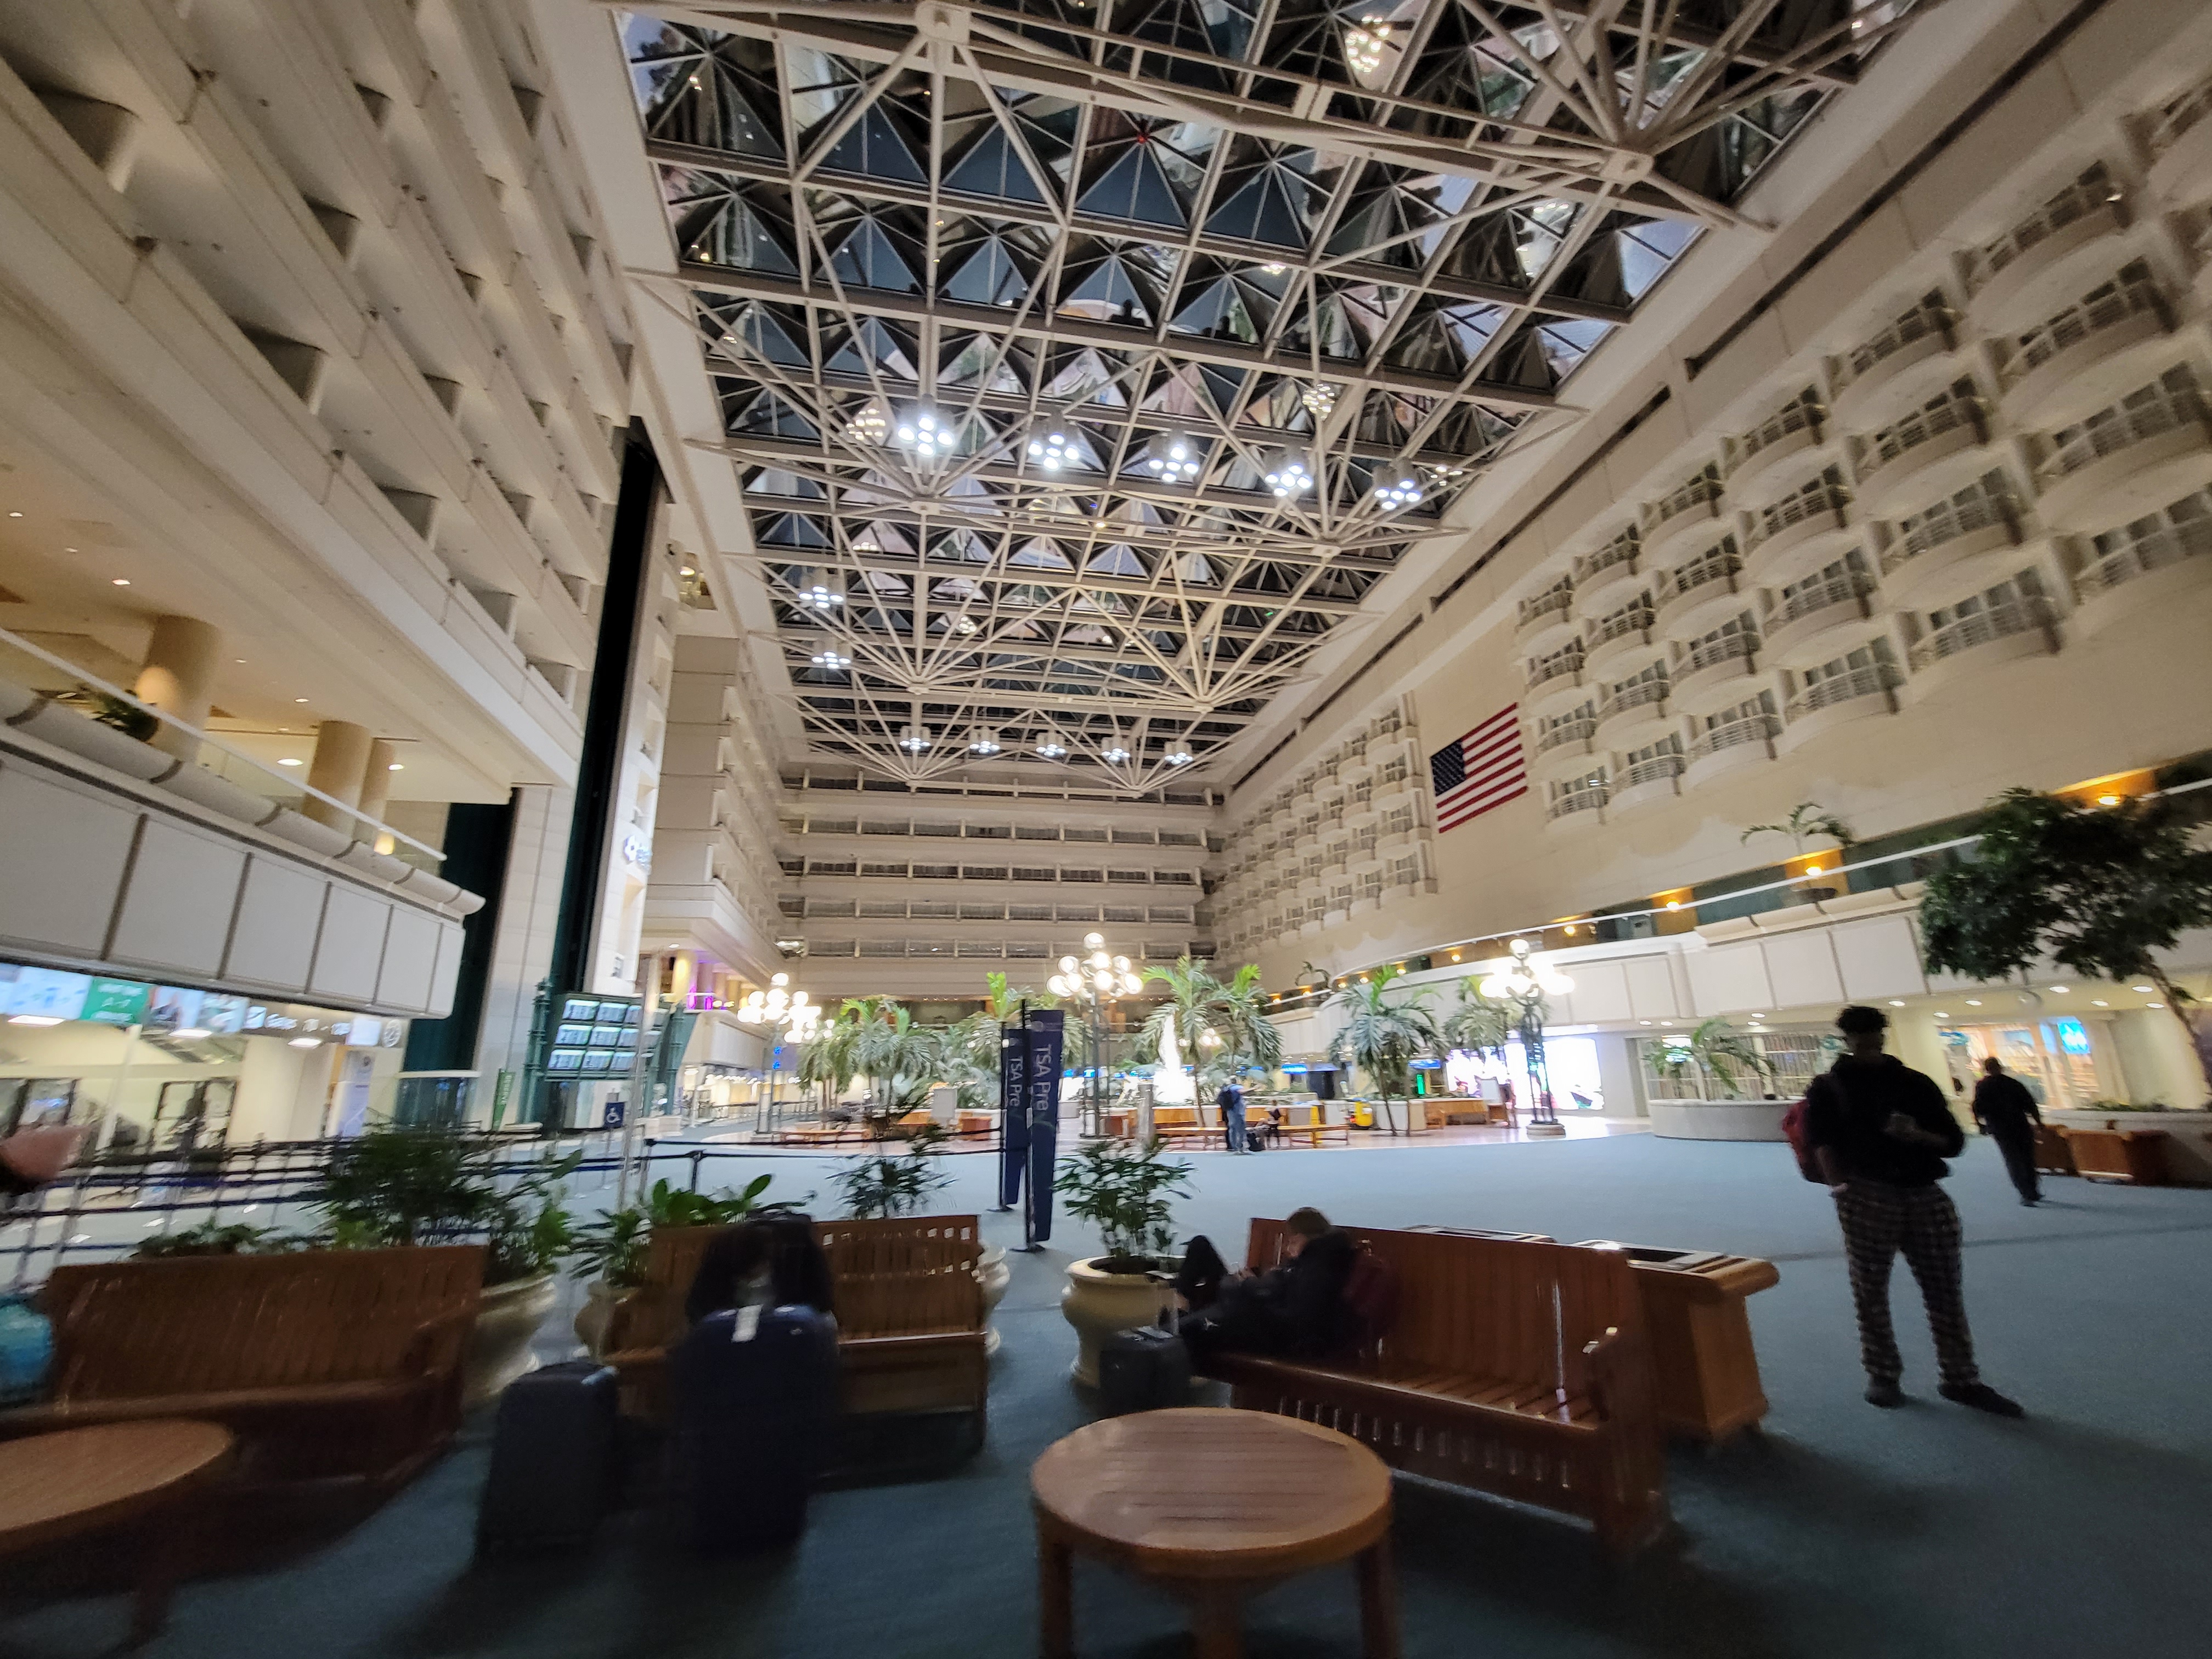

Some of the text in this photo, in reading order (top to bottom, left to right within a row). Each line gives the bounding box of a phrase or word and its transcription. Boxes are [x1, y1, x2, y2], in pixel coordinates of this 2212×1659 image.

[1009, 1056, 1023, 1107] TSA Pre
[1033, 1044, 1052, 1111] TSA Pre
